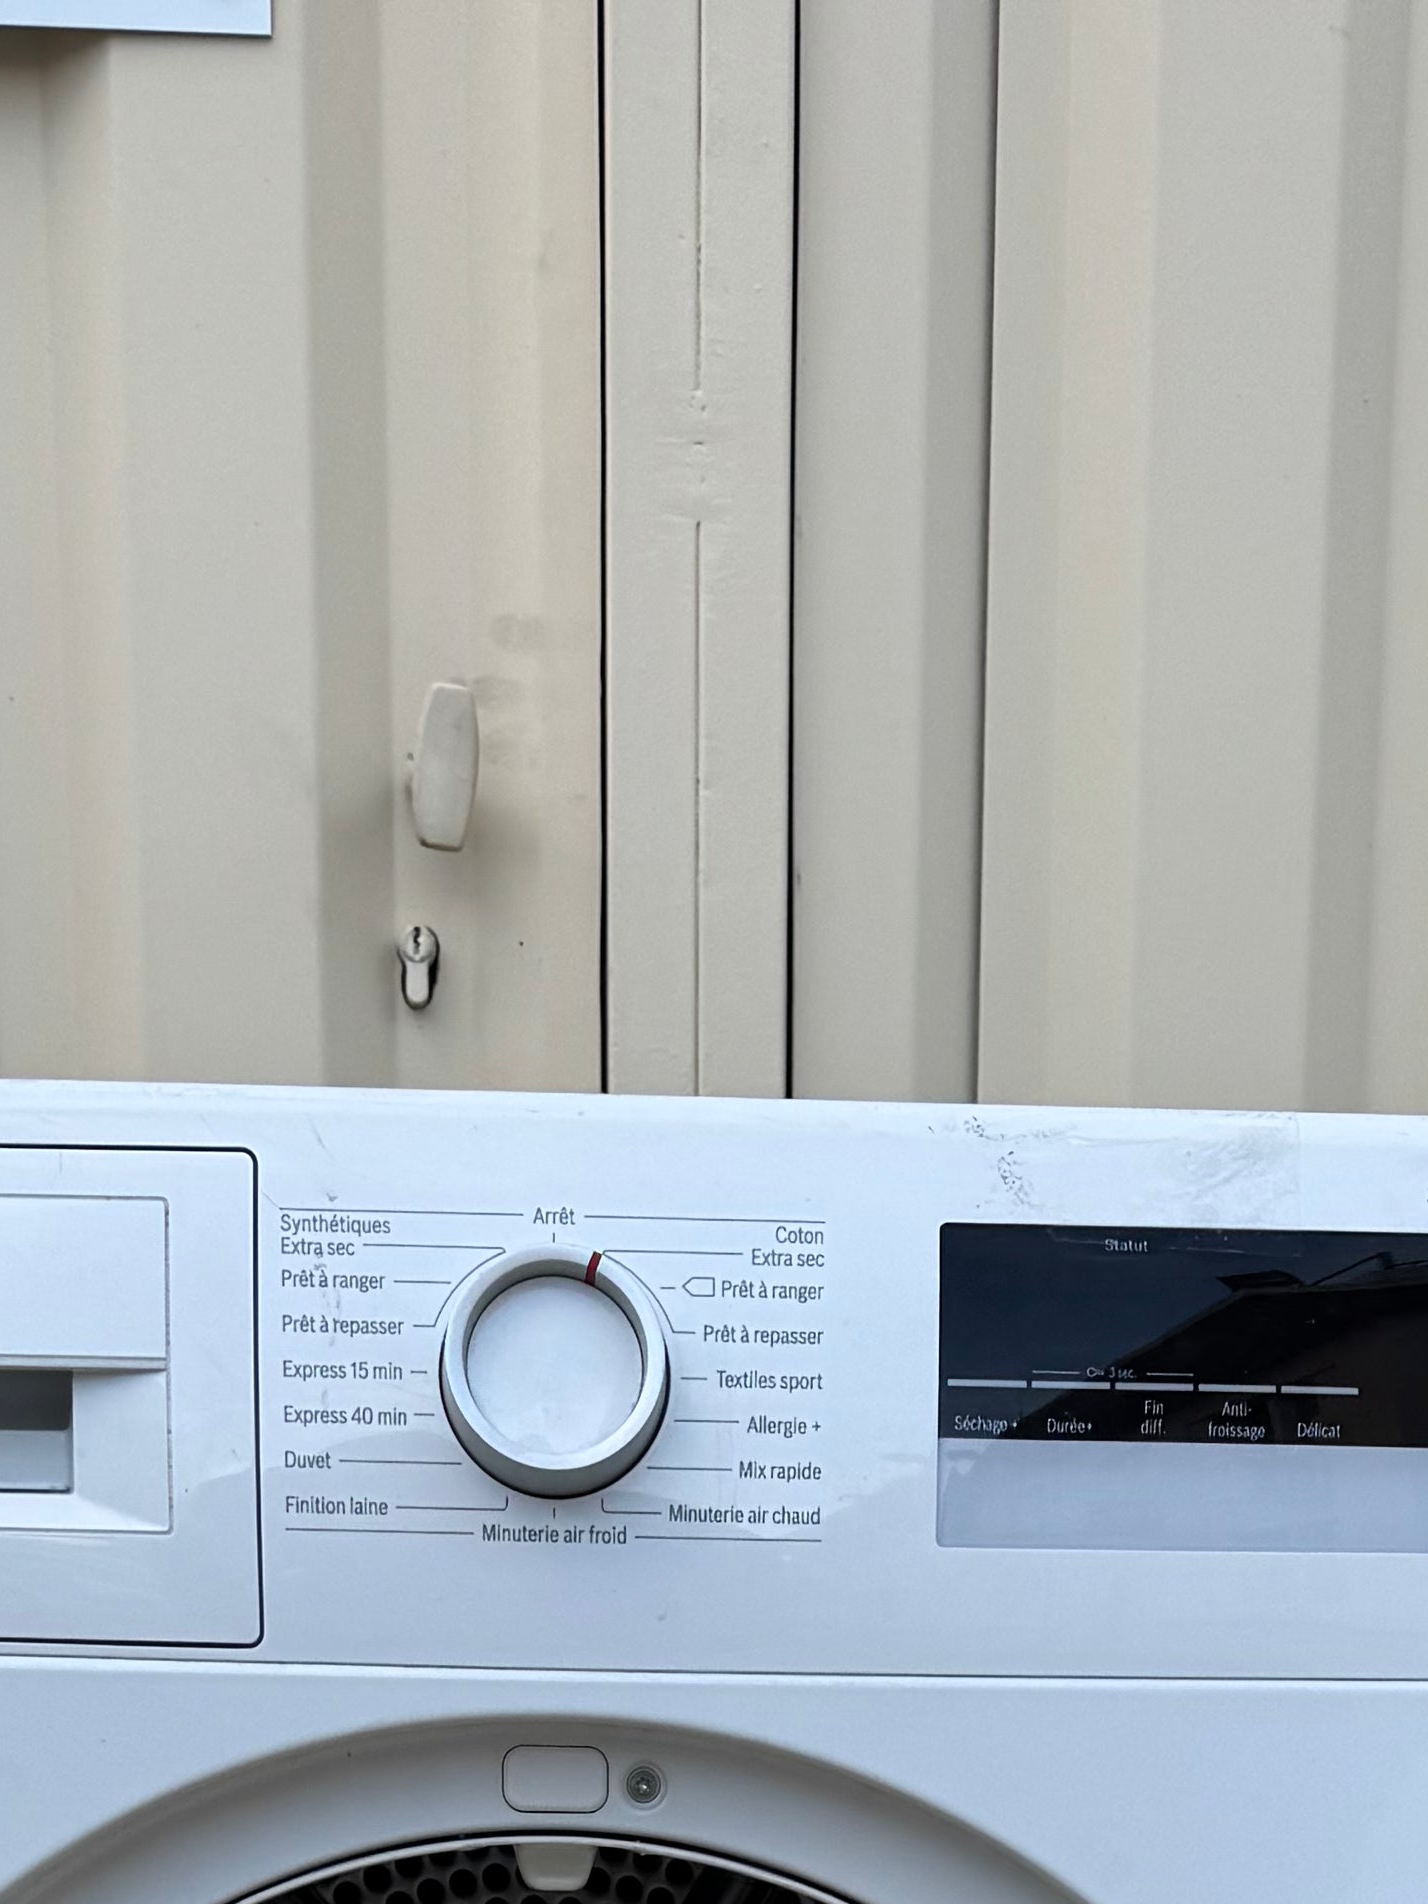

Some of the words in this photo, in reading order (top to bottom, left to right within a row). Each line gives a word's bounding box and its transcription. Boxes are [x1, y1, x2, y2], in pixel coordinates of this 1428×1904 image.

[279, 1213, 391, 1237] Synthétiques
[532, 1206, 576, 1225] Arrêt
[280, 1236, 323, 1255] Extra
[327, 1241, 355, 1256] sec
[775, 1225, 824, 1245] Coton
[1104, 1238, 1148, 1252] Statut
[751, 1248, 793, 1266] Extra
[797, 1252, 825, 1267] sec
[281, 1269, 315, 1288] Prêt
[318, 1269, 328, 1288] à
[332, 1274, 386, 1293] ranger
[721, 1279, 755, 1299] Prêt
[758, 1280, 768, 1299] à
[772, 1285, 825, 1304] ranger
[282, 1314, 316, 1333] Prêt
[320, 1314, 329, 1333] à
[333, 1318, 404, 1337] repasser
[703, 1324, 737, 1343] Prêt
[740, 1324, 750, 1343] à
[754, 1330, 824, 1348] repasser
[282, 1359, 347, 1382] Express
[350, 1361, 369, 1380] 15
[373, 1362, 403, 1380] min
[716, 1369, 776, 1389] Textiles
[780, 1373, 824, 1393] sport
[283, 1405, 347, 1427] Express
[351, 1406, 374, 1425] 40
[377, 1407, 408, 1426] min
[1143, 1400, 1164, 1415] Fin
[746, 1414, 807, 1438] Allergie
[1207, 1421, 1266, 1441] froissage
[1297, 1421, 1341, 1439] Délicat
[284, 1450, 332, 1469] Duvet
[738, 1460, 767, 1480] Mix
[770, 1461, 822, 1483] rapide
[285, 1495, 346, 1515] Finition
[350, 1496, 389, 1516] laine
[669, 1503, 744, 1523] Minuterie
[747, 1505, 769, 1524] air
[772, 1505, 821, 1525] chaud
[482, 1523, 559, 1543] Minuterie
[563, 1525, 585, 1544] air
[589, 1524, 627, 1545] froid
